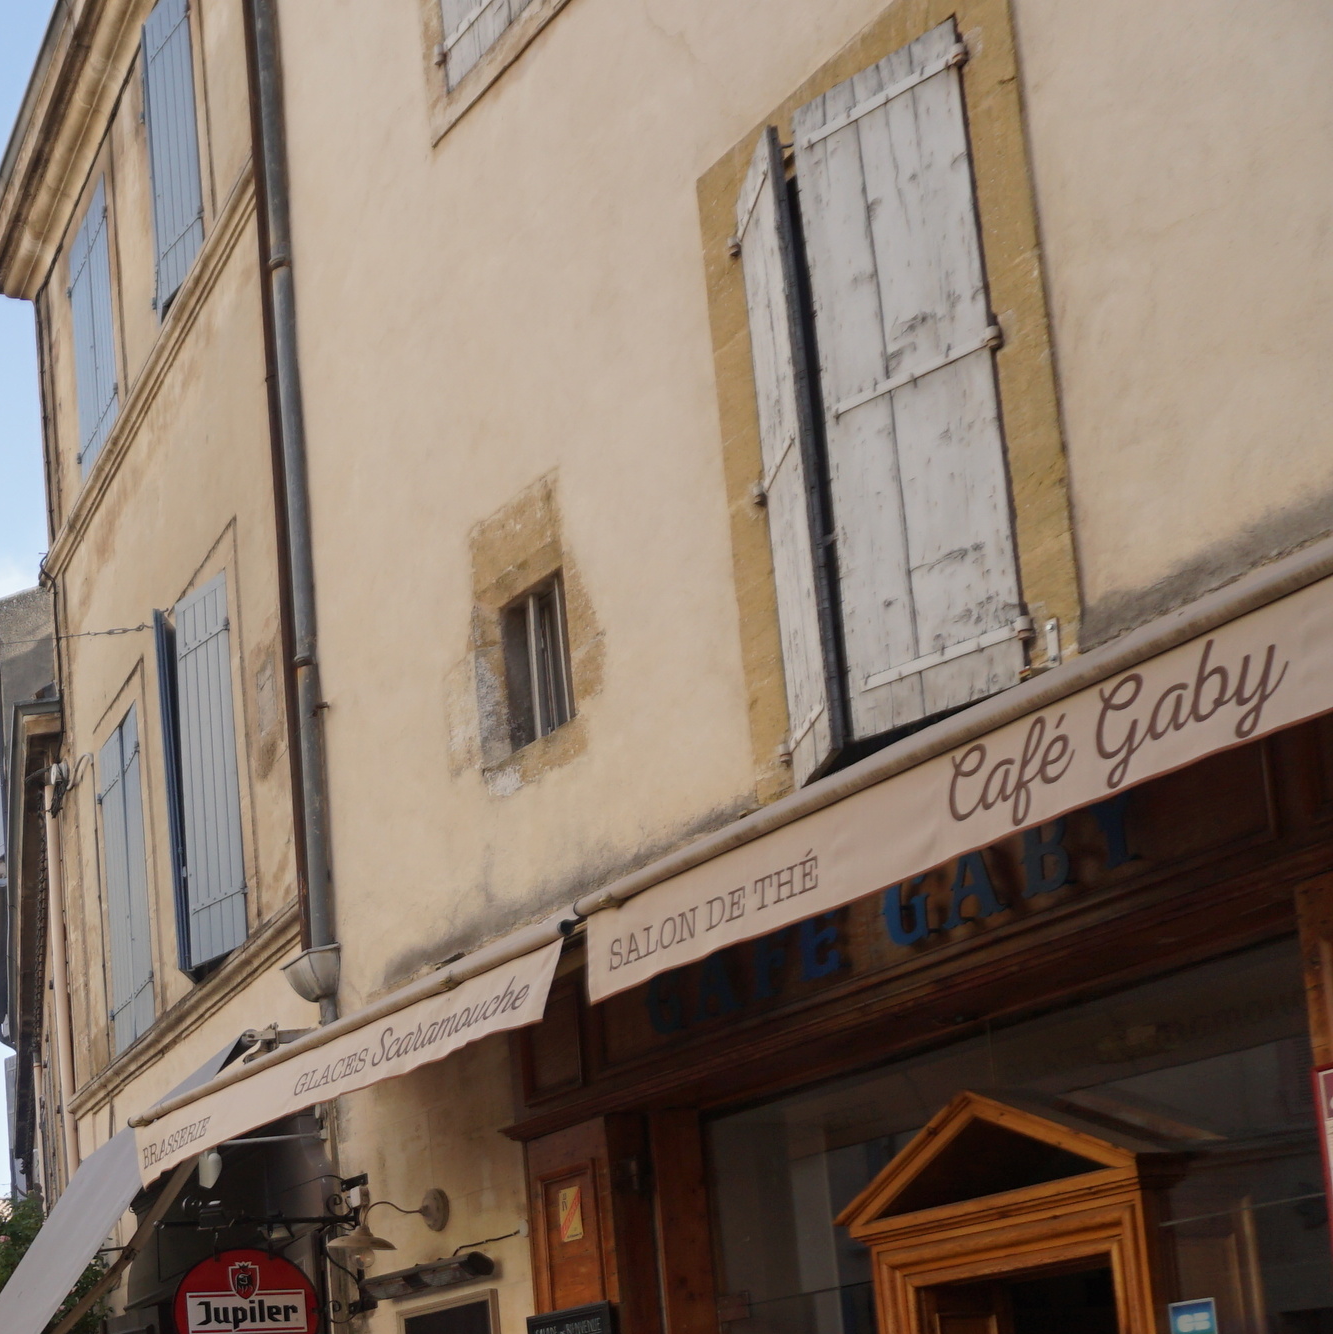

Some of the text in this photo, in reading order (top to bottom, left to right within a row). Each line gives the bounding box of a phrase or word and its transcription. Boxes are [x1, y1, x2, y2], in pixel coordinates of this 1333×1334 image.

[948, 639, 1289, 826] Café Gaby
[608, 849, 820, 972] SALON DE THÉ
[883, 793, 1141, 947] GABY
[293, 976, 530, 1097] GLACES Scaramouche
[142, 1115, 211, 1170] BRASSERIE
[196, 1299, 299, 1330] Jupiler
